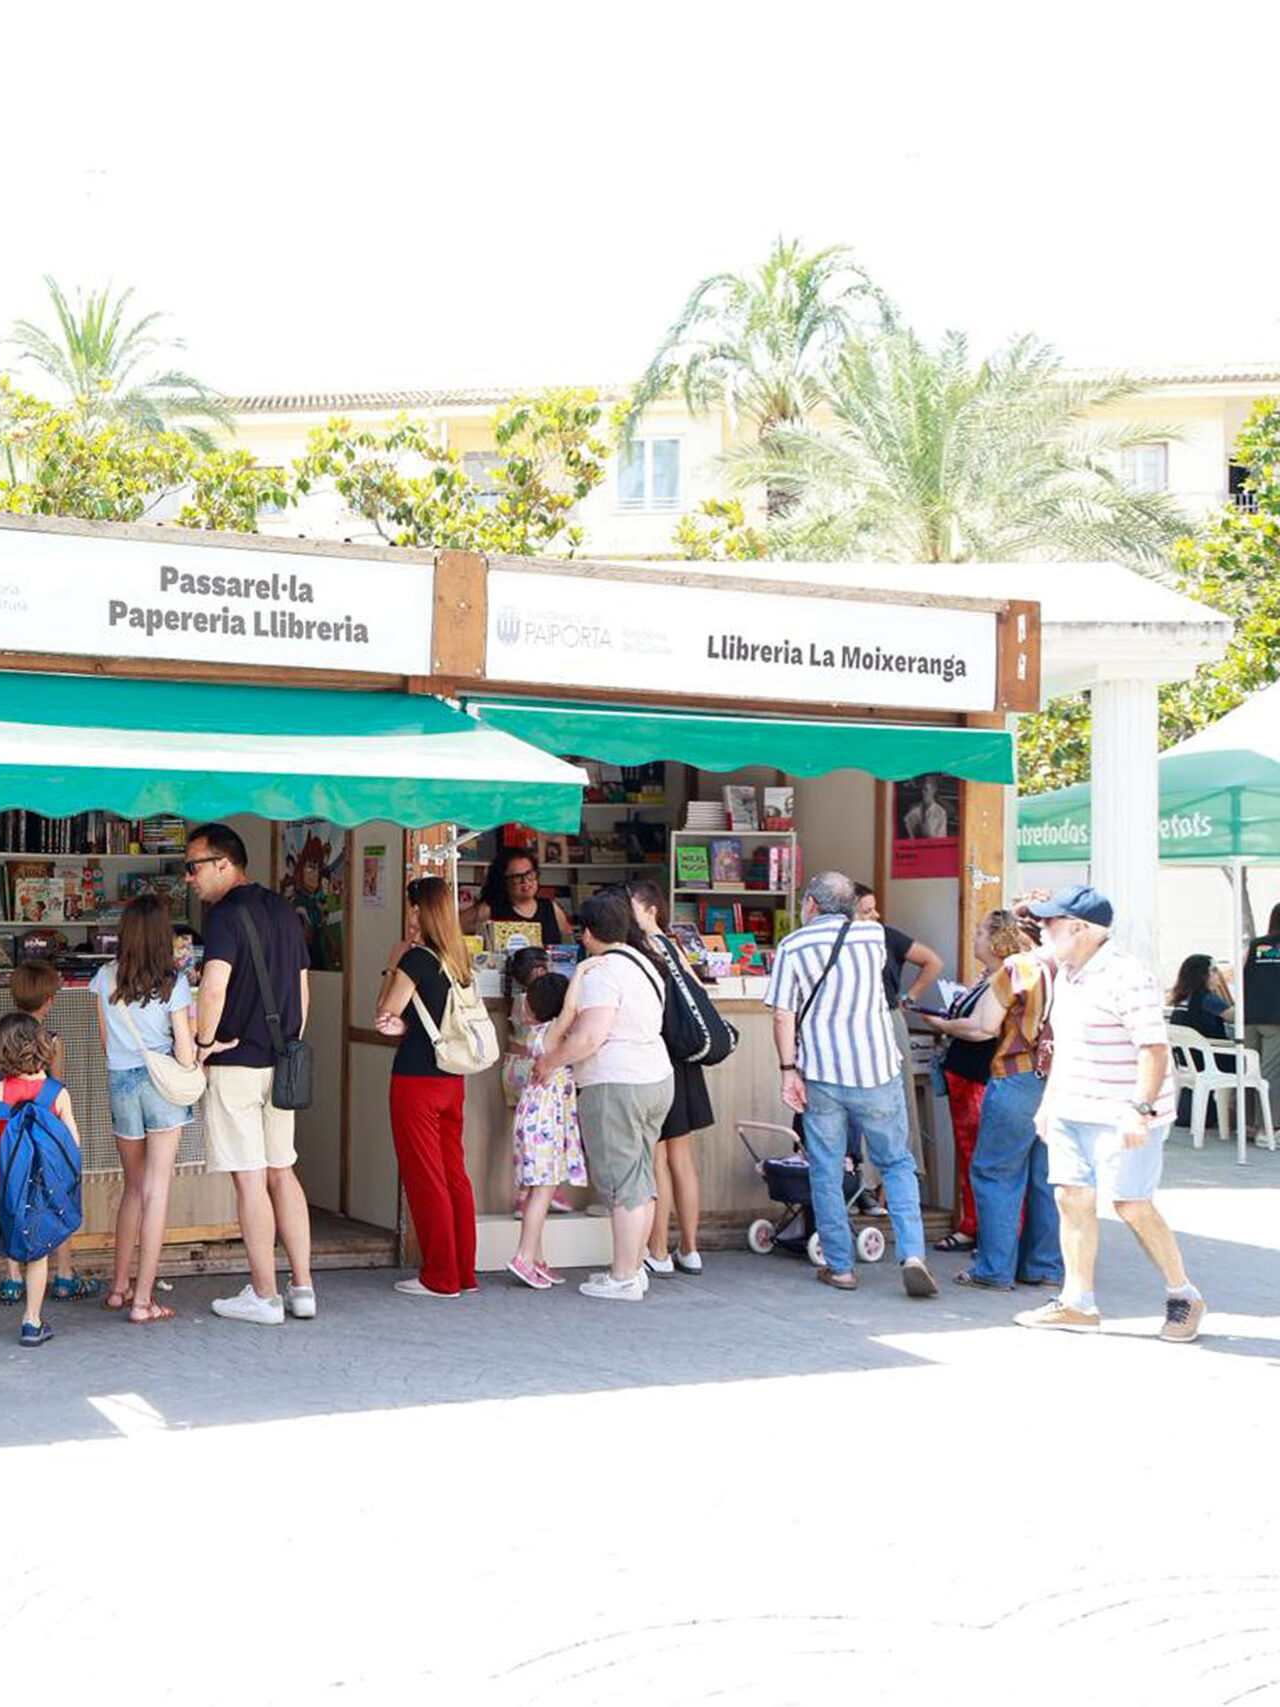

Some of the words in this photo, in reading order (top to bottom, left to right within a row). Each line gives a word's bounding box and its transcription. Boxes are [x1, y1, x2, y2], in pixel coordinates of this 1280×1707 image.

[160, 565, 314, 603] Passarel·la
[108, 600, 246, 636] Papereria
[254, 610, 369, 643] Llibreria
[525, 622, 613, 649] PAIPORTA
[707, 635, 803, 665] Llibreria
[810, 643, 835, 667] La
[841, 645, 966, 682] Moixeranga
